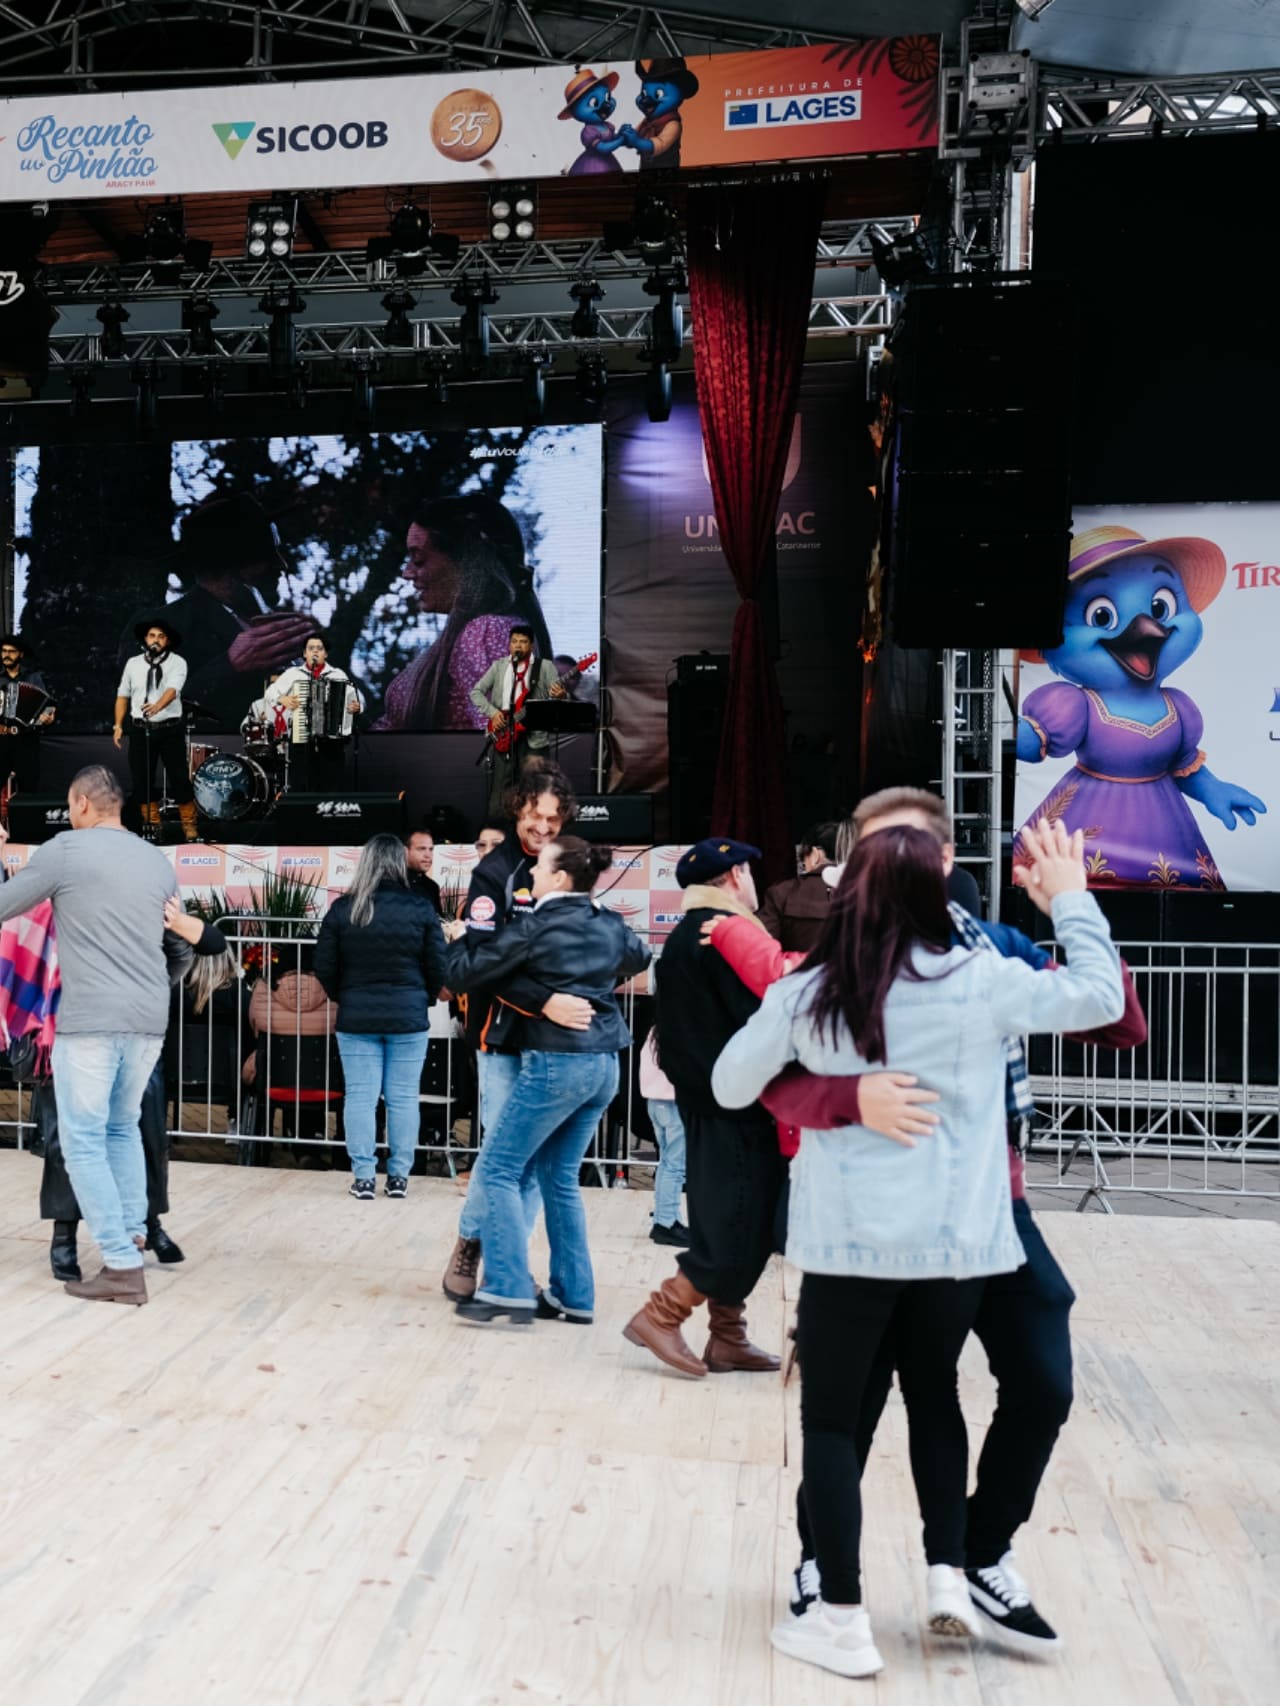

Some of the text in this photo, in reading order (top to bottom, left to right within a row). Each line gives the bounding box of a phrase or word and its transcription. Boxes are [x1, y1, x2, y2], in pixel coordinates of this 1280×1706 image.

[725, 78, 863, 97] PREFEITURA DE
[766, 96, 856, 122] LAGES
[17, 114, 154, 160] Recanto
[256, 121, 389, 153] SICOOB
[441, 111, 488, 146] 35
[48, 147, 159, 183] Pinhão
[685, 511, 816, 538] UNAC
